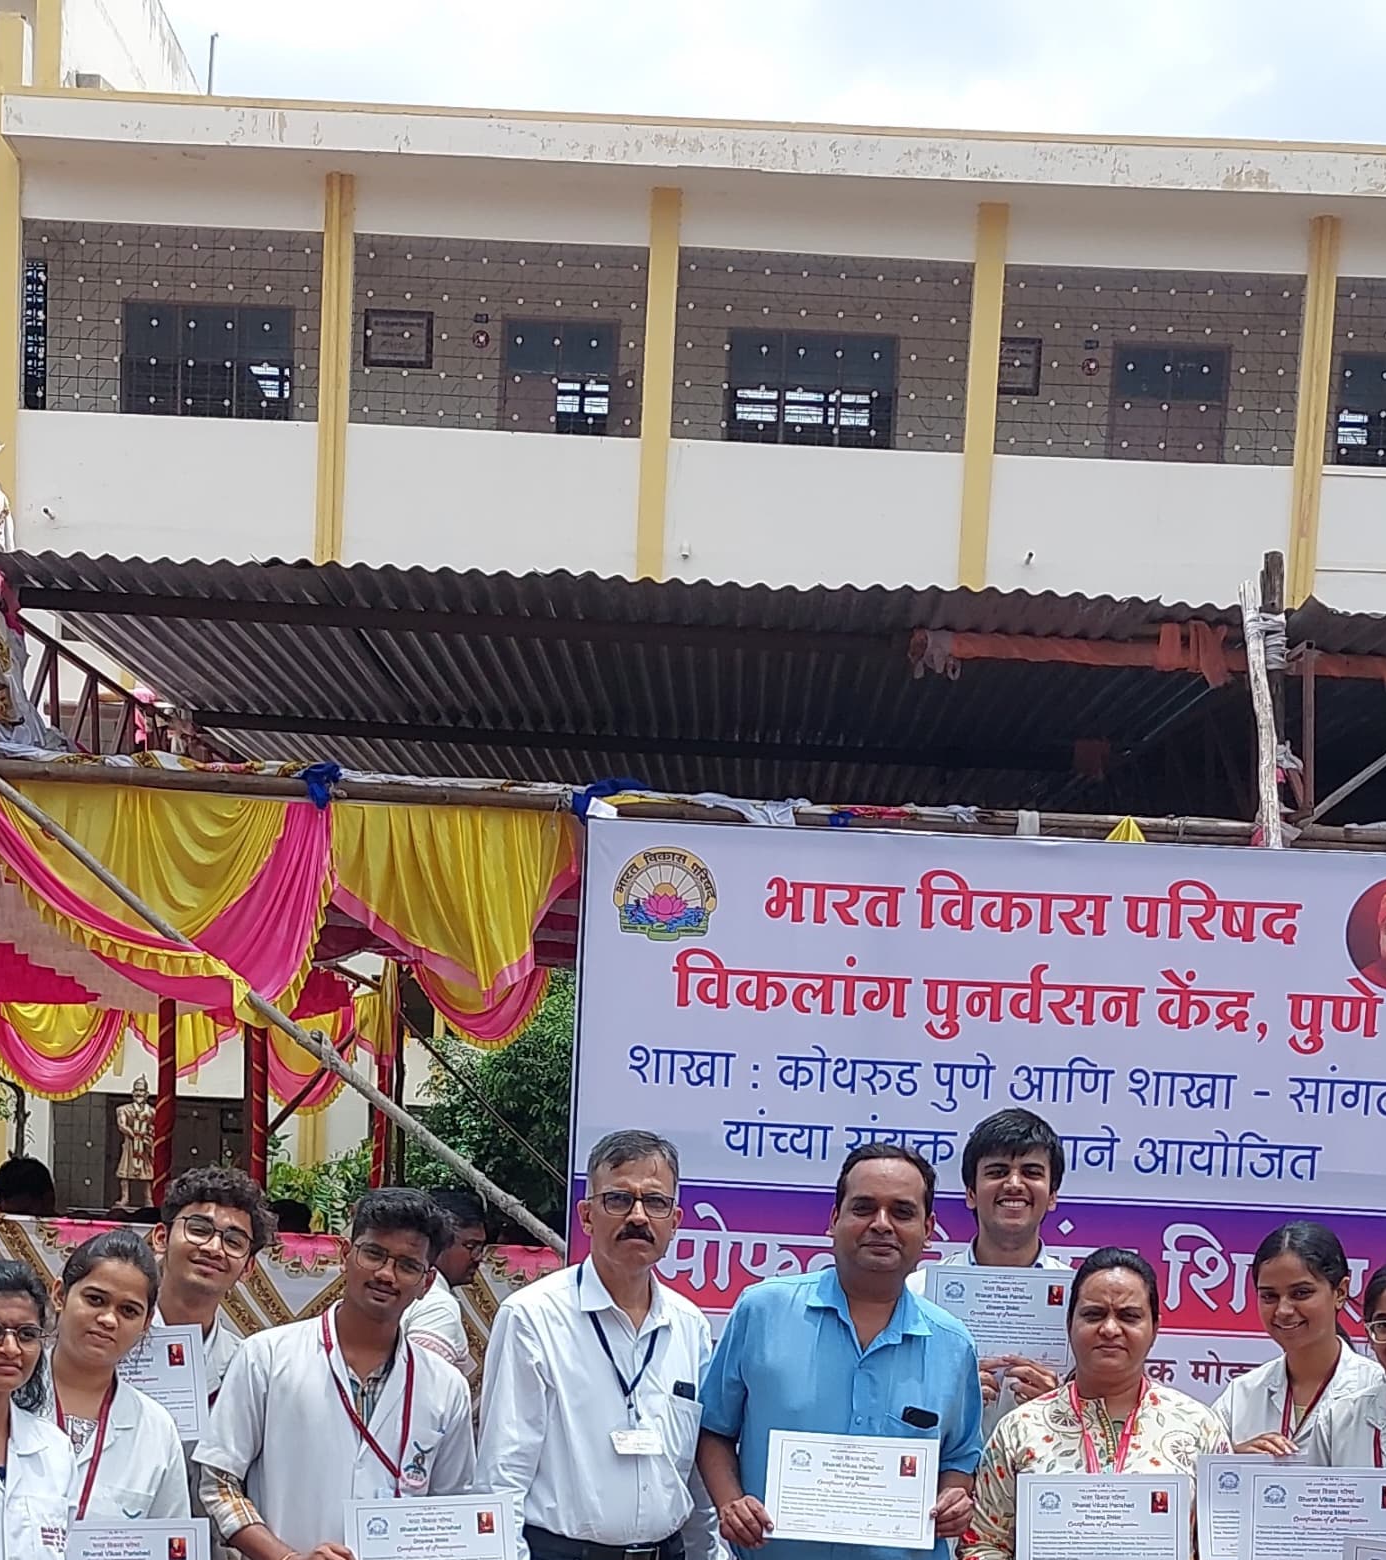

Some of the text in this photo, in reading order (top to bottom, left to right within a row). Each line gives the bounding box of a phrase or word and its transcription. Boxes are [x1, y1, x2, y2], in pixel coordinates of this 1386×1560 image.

[616, 862, 640, 893] भारत
[644, 852, 687, 865] विकास
[764, 869, 1303, 945] भारत विकास परिषद
[672, 947, 1384, 1055] विकलांग पुनर्वसन केंद्र, पुणे
[628, 1043, 736, 1089] शाखा
[776, 1045, 922, 1096] कोथरुड
[931, 1052, 996, 1112] पुणे
[1009, 1056, 1115, 1105] आणि
[1128, 1067, 1238, 1111] शाखा
[723, 1108, 833, 1161] यांच्या
[1134, 1130, 1323, 1182] आयोजित
